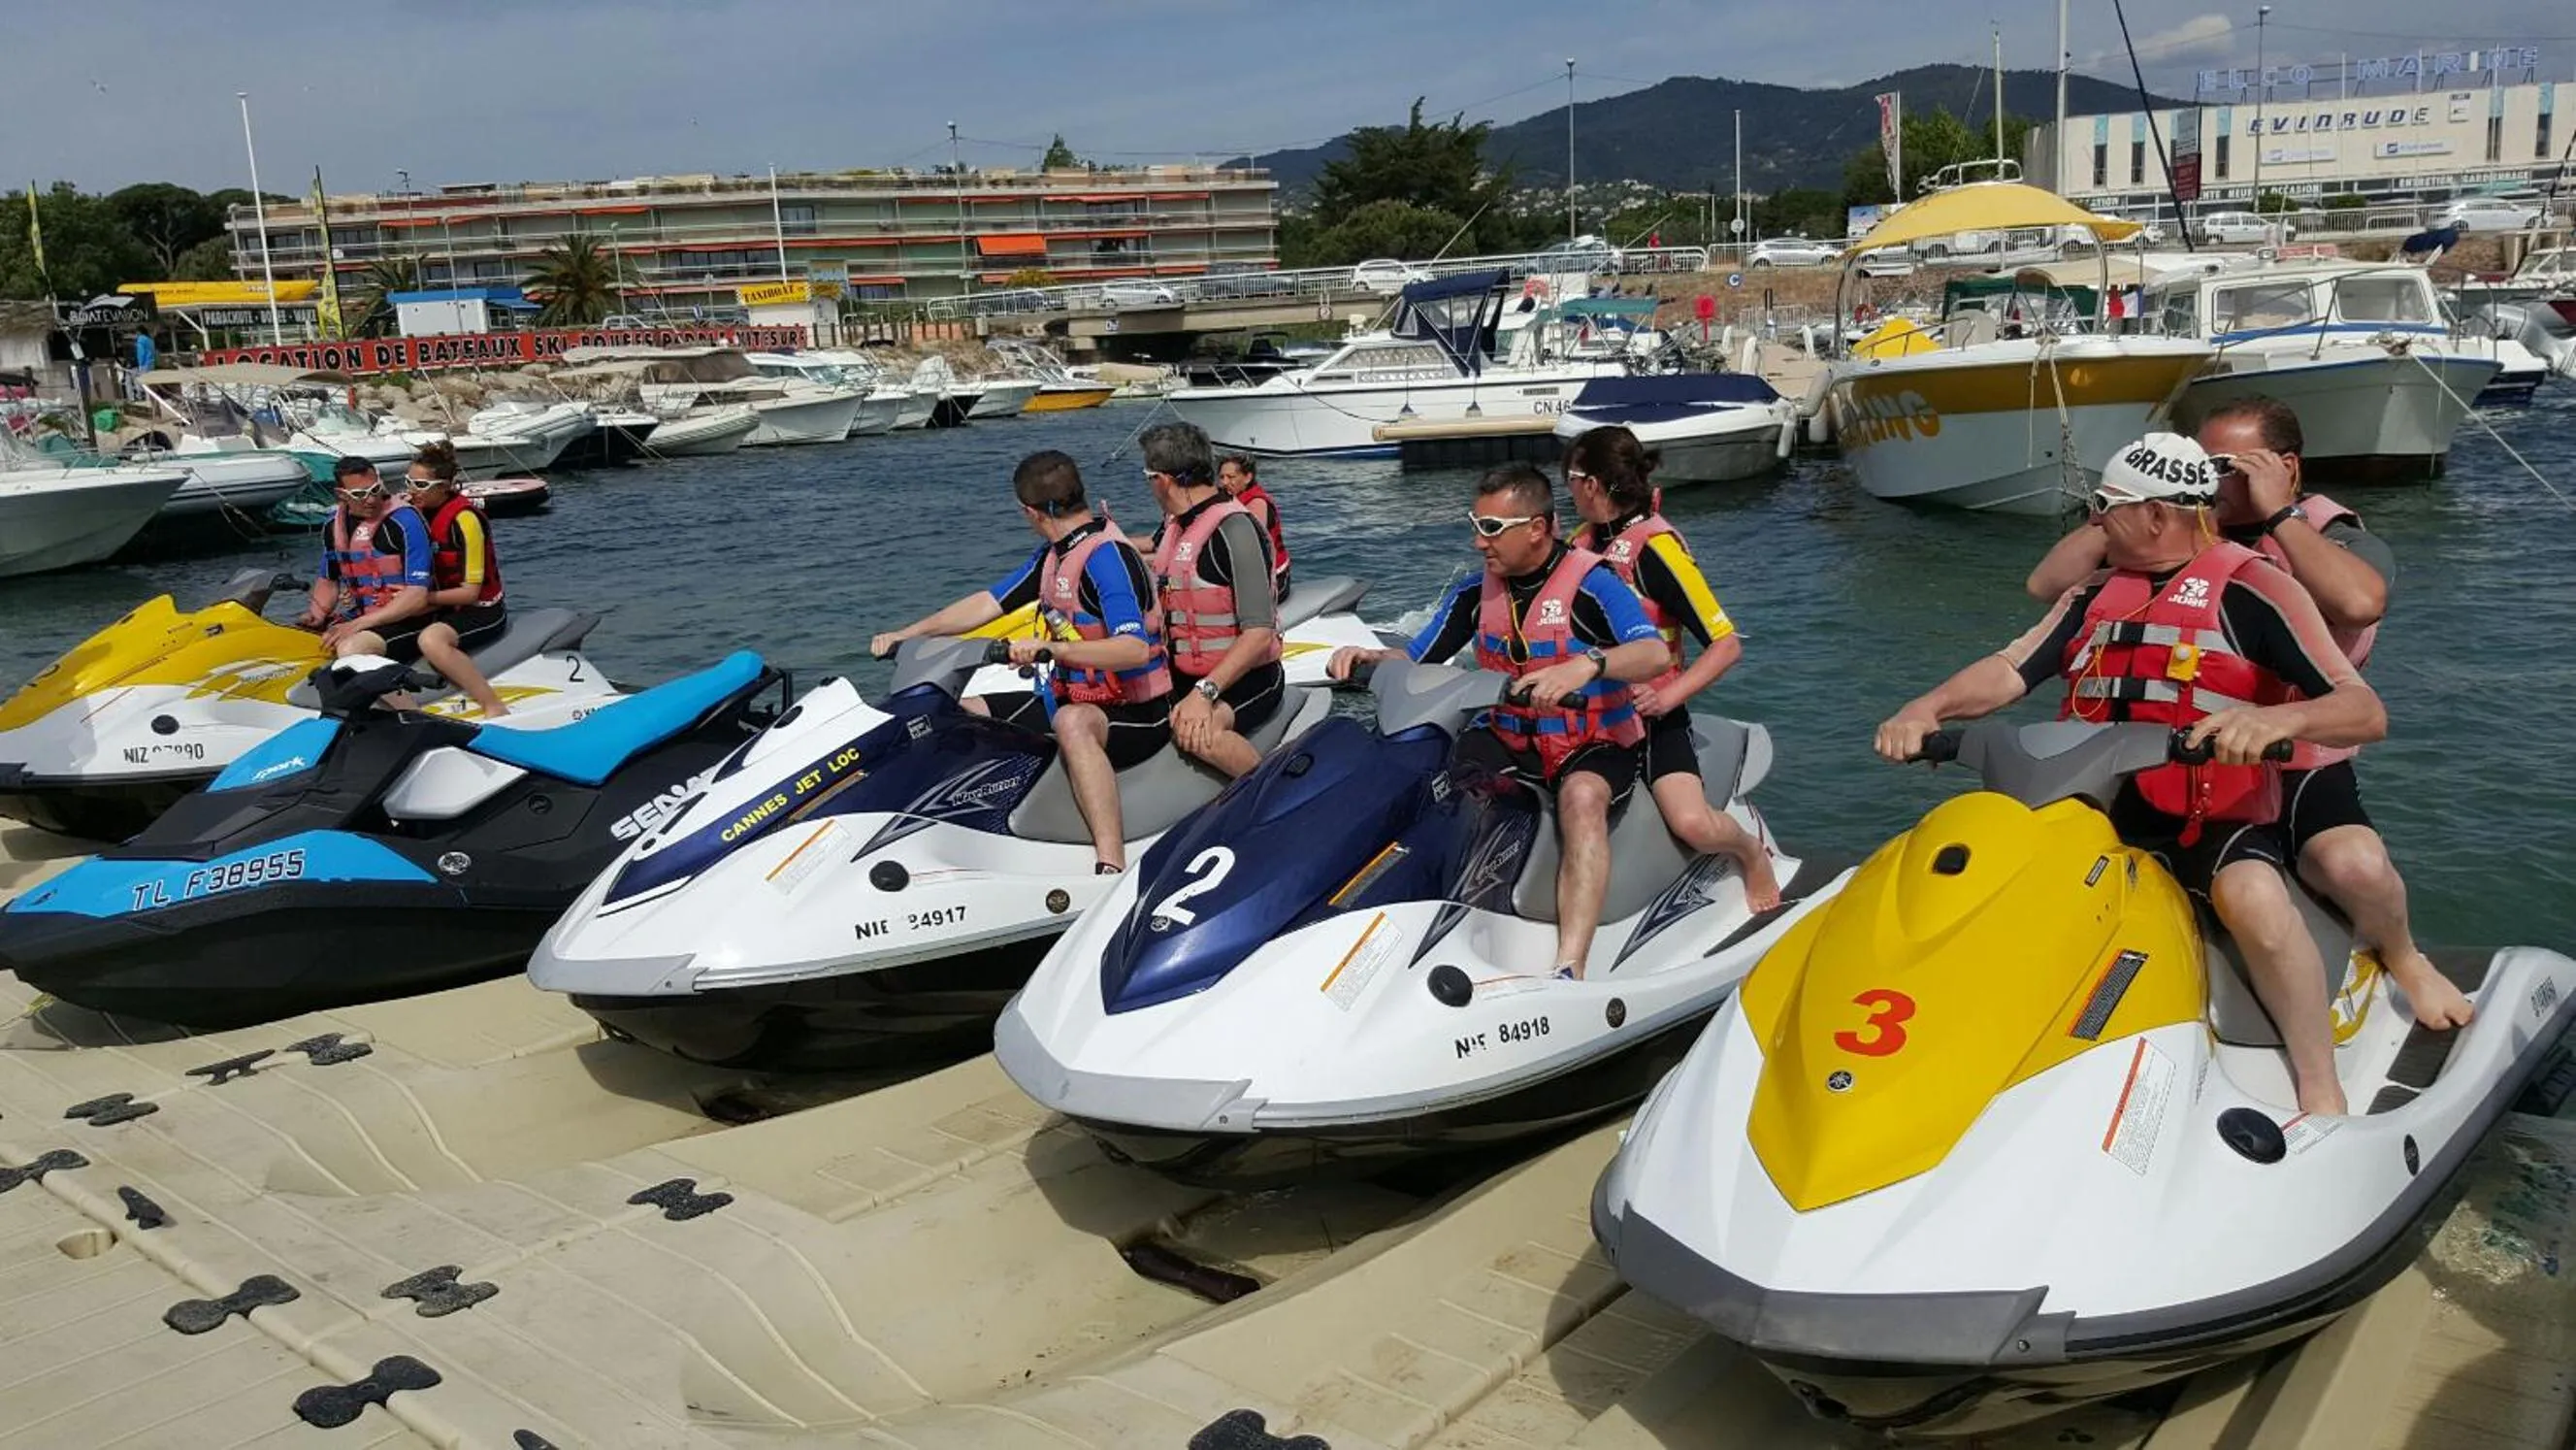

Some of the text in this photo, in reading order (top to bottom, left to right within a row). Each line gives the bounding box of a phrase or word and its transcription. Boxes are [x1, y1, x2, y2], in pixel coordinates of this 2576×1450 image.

[2357, 46, 2538, 81] MARINE
[2250, 107, 2430, 132] EVINRUDE
[375, 343, 407, 367] DE
[417, 334, 522, 365] BATEAUX
[1533, 401, 1552, 414] CN
[2124, 447, 2210, 485] GRASSE
[566, 654, 585, 683] 2
[123, 746, 149, 764] NIZ
[721, 747, 860, 841] CANNES JET LOC
[131, 847, 307, 912] TL F38955
[1152, 845, 1236, 926] 2
[855, 918, 889, 939] NIE
[1499, 1016, 1550, 1043] 84918
[1833, 988, 1917, 1057] 3
